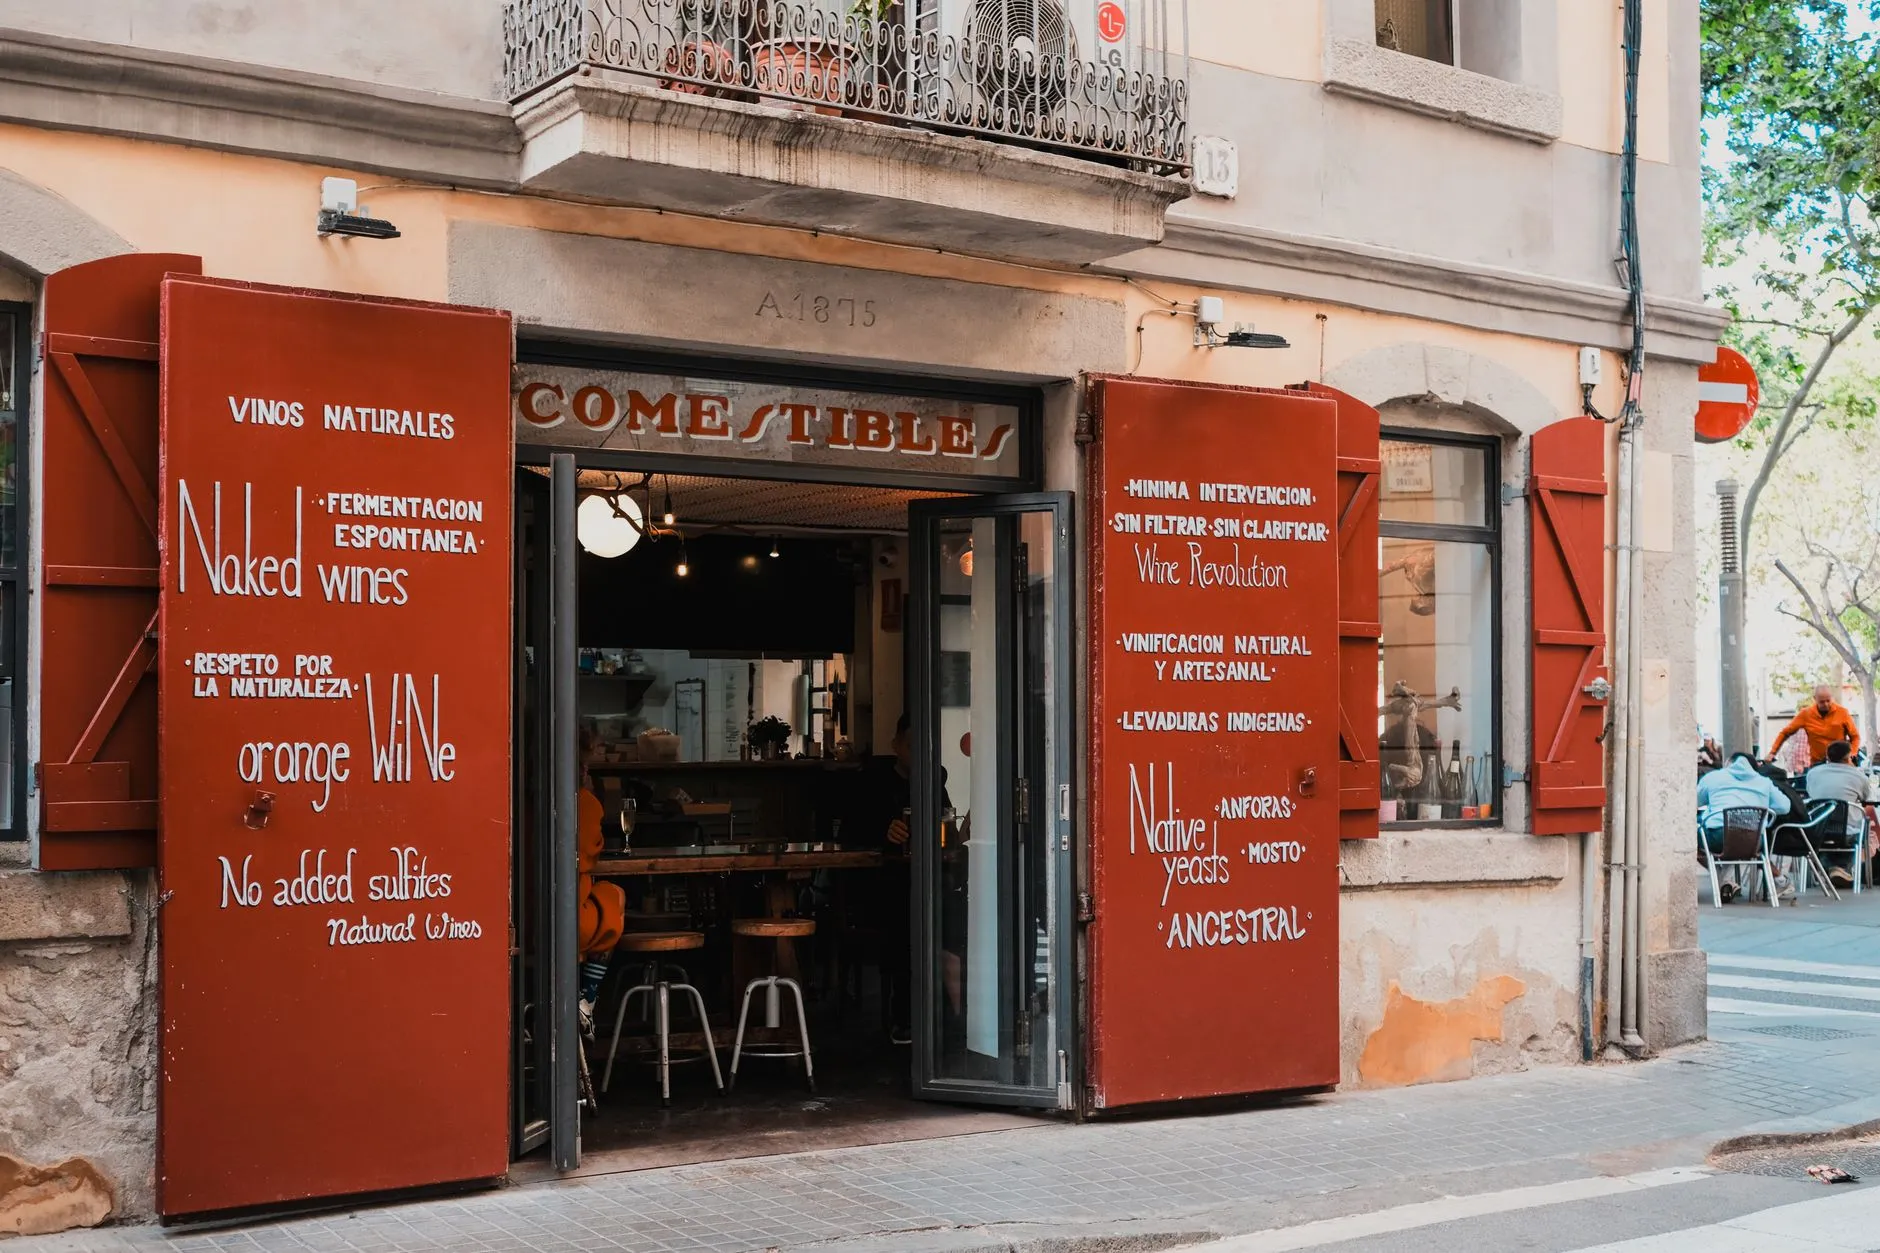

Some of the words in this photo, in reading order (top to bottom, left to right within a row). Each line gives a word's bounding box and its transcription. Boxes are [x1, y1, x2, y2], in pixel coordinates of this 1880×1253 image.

[1099, 47, 1122, 67] LG
[1206, 150, 1230, 183] 13
[228, 395, 305, 428] VINOS
[323, 403, 456, 440] NATURALES
[518, 381, 1015, 461] COMESTIBLES
[178, 478, 302, 598] Naked
[317, 564, 409, 606] wines
[1134, 542, 1181, 585] Wine
[1186, 541, 1289, 589] Revolution
[295, 654, 333, 676] POR
[1234, 635, 1312, 656] NATURAL
[194, 676, 219, 698] LA
[1154, 660, 1167, 681] Y
[238, 741, 350, 813] orange
[1129, 761, 1206, 854] Native
[218, 854, 262, 908] No
[272, 847, 357, 906] added
[368, 846, 452, 901] sulfites
[1161, 820, 1230, 907] yeasts
[425, 911, 483, 940] Wines
